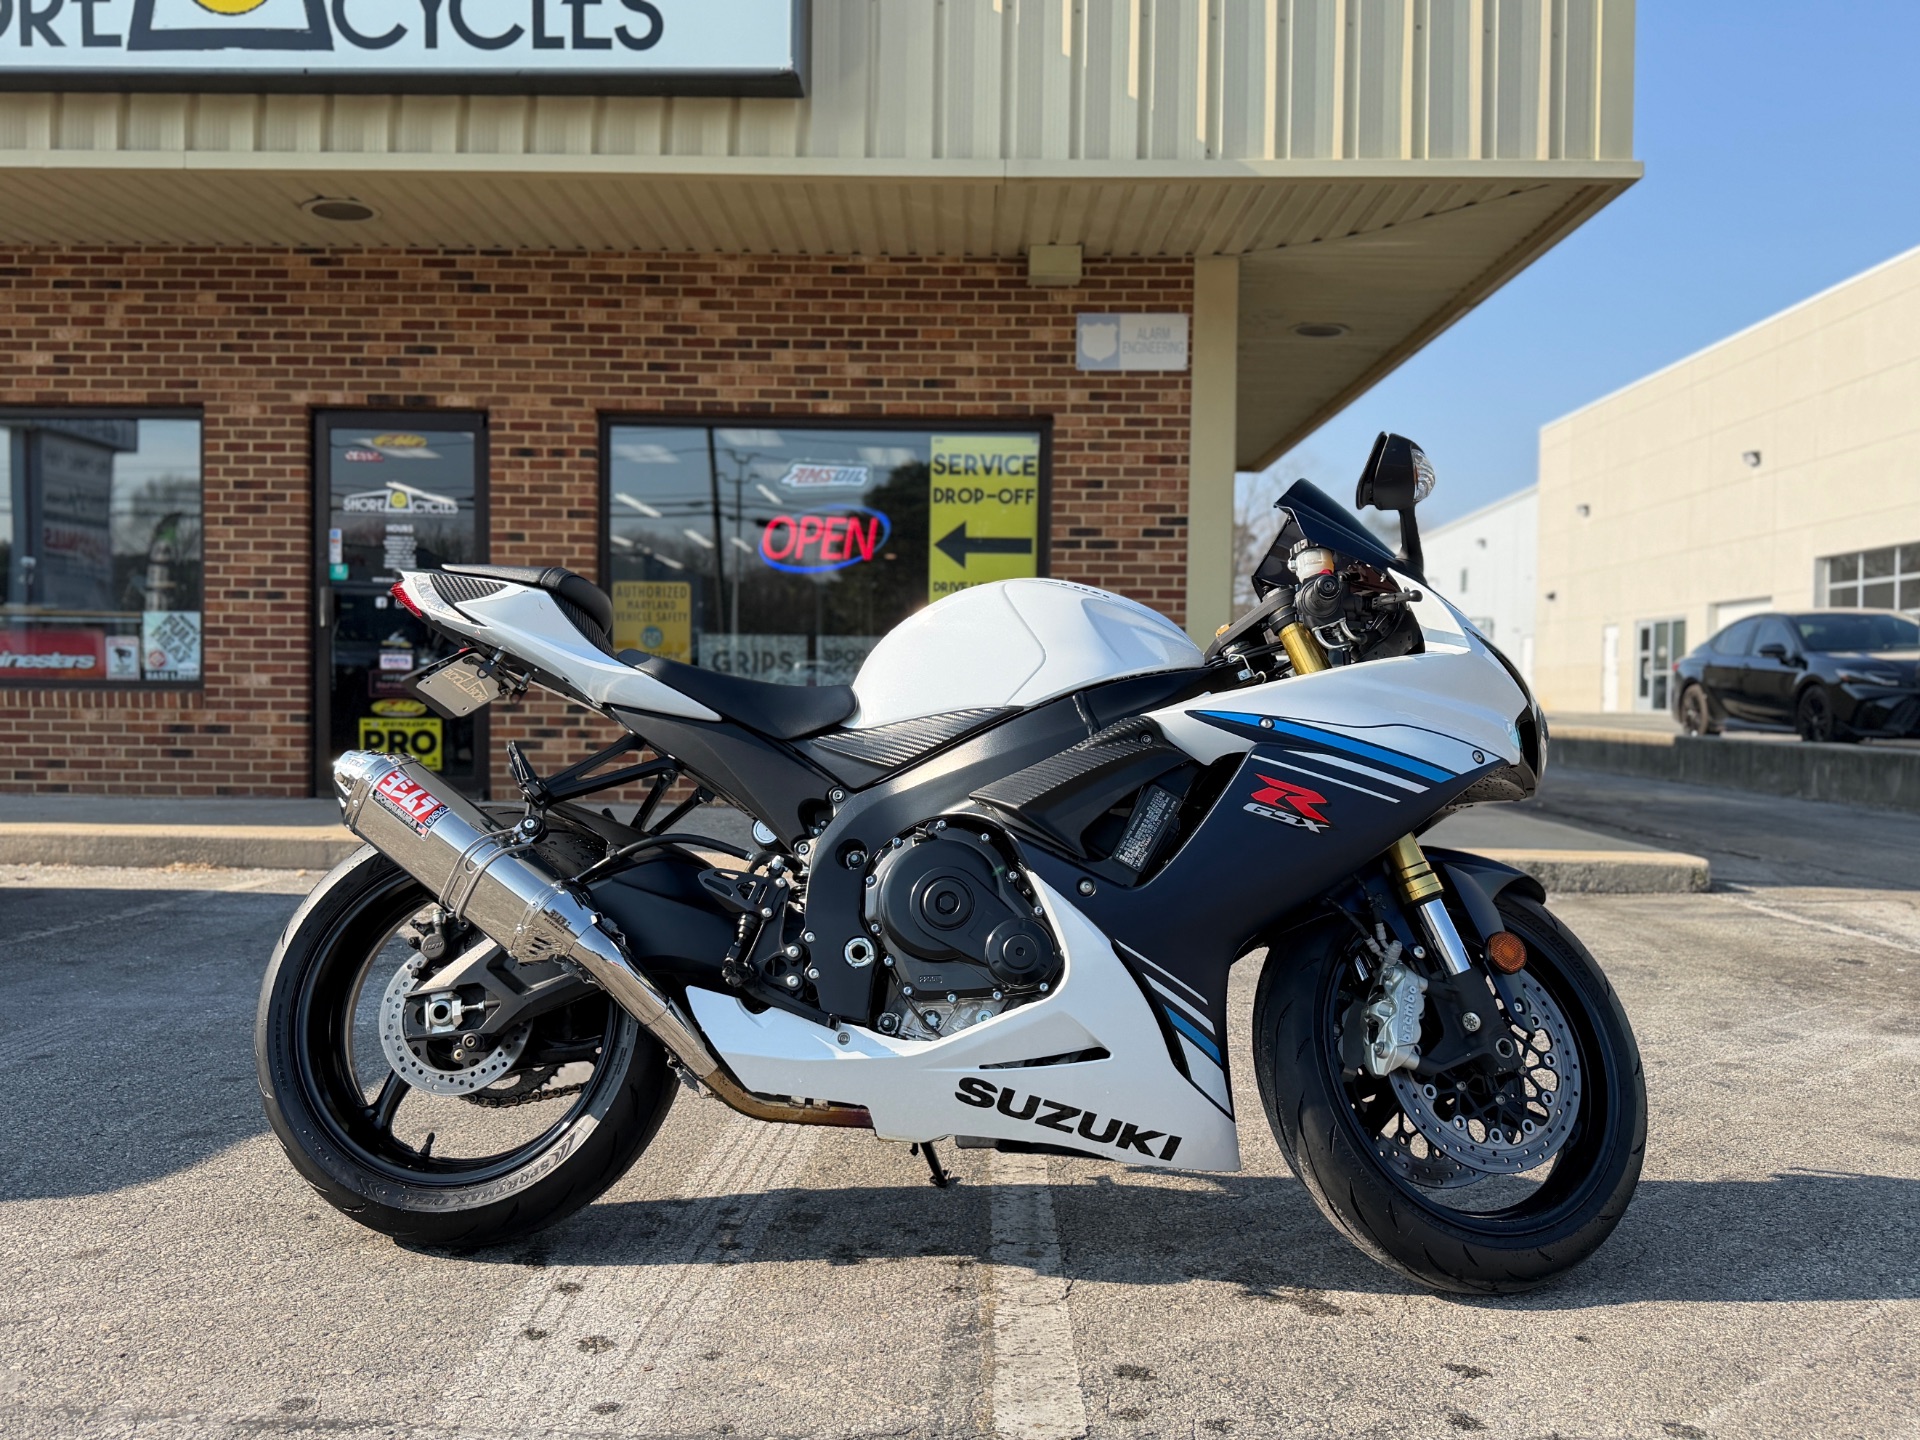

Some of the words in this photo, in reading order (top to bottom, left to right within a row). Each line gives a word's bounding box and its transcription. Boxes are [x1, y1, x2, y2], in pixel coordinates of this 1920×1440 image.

[0, 0, 122, 47] RE
[1137, 327, 1171, 340] ALARM
[1122, 341, 1185, 354] ENGINEERING
[786, 466, 867, 486] AMSOIL
[933, 453, 1037, 477] SERVICE
[343, 498, 384, 512] SHORE
[413, 500, 459, 514] CYCLES
[933, 487, 1035, 505] DROP-OFF
[762, 514, 879, 561] OPEN
[616, 586, 688, 599] AUTHORIZED
[615, 612, 652, 621] VEHICLE
[656, 612, 688, 622] SAFETY
[626, 601, 676, 610] MARYLAND
[0, 650, 96, 669] inestars
[712, 651, 793, 674] GRIPS
[364, 730, 437, 755] PRO
[1251, 773, 1330, 824] R
[424, 804, 451, 827] USA
[1242, 802, 1331, 834] GSX
[1399, 985, 1417, 1043] brembo
[955, 1076, 1183, 1161] SUZUKI
